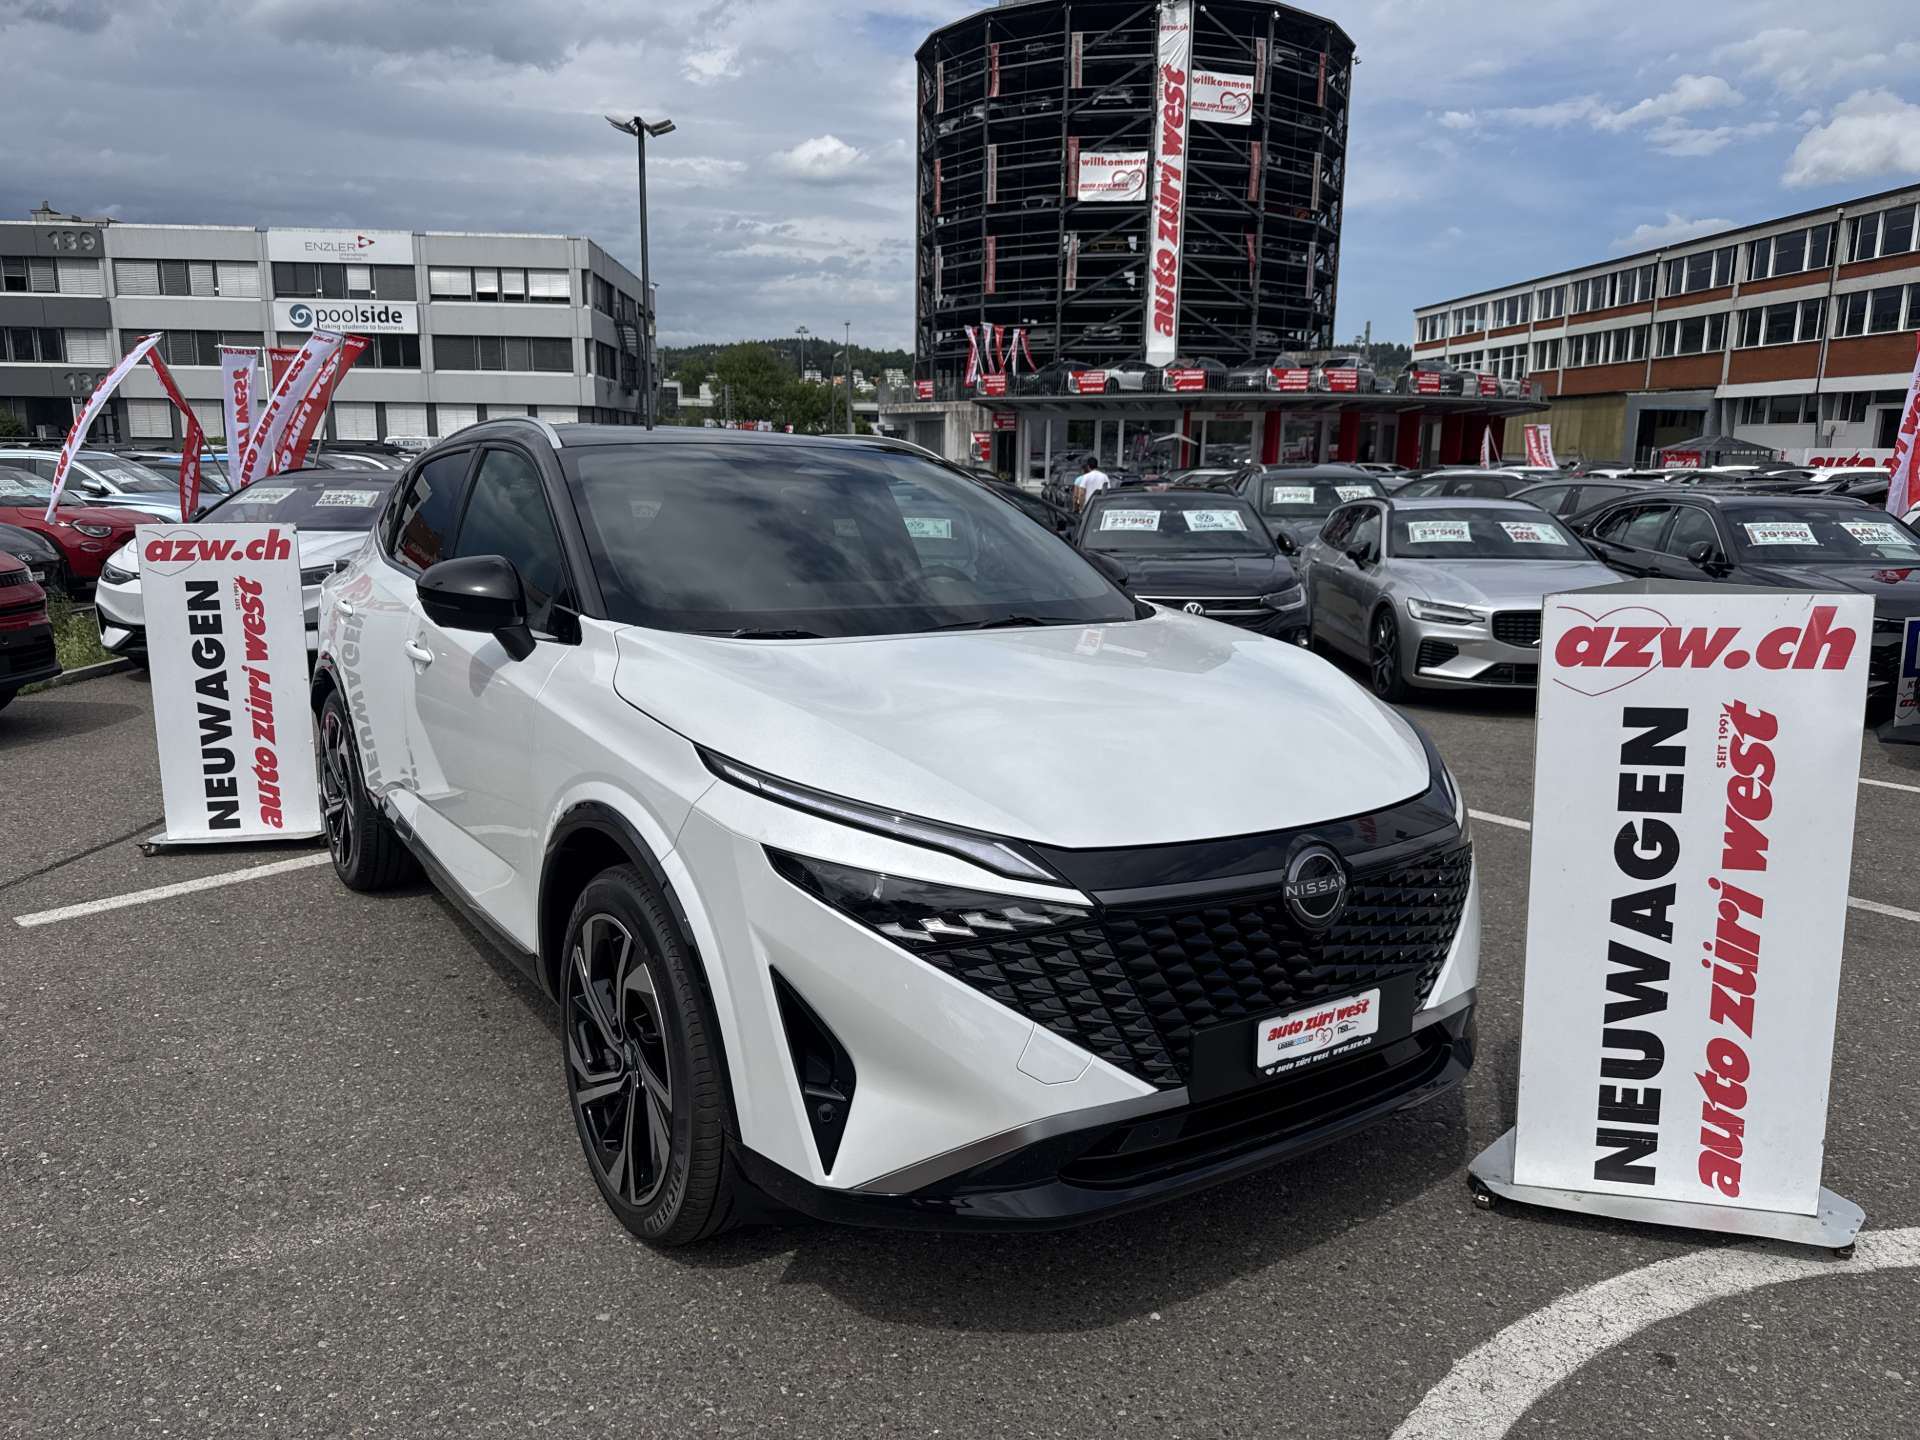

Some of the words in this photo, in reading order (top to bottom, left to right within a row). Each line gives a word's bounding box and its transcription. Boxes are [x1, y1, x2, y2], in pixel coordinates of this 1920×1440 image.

[1162, 63, 1185, 156] west
[1192, 75, 1252, 90] willkommen
[1081, 156, 1146, 167] willkommen
[1154, 159, 1183, 248] züri
[48, 231, 96, 250] 139
[305, 241, 356, 252] ENZLER
[316, 305, 403, 328] poolside
[1153, 247, 1177, 338] auto
[144, 529, 292, 562] azw.ch
[1759, 530, 1809, 538] 39'950
[233, 575, 270, 661] west
[1555, 606, 1857, 670] azw.ch
[185, 580, 241, 830] NEUWAGEN
[241, 665, 277, 746] züri
[1718, 713, 1730, 740] 1991
[1716, 744, 1727, 769] SEIT
[250, 746, 284, 830] auto
[1720, 699, 1779, 871] west
[1285, 874, 1346, 897] NISSAN
[1594, 706, 1689, 1186] NEUWAGEN
[1701, 876, 1766, 1039] züri
[1267, 1020, 1304, 1042] auto
[1304, 1007, 1337, 1032] züri
[1337, 998, 1370, 1021] west
[1276, 1062, 1295, 1073] auto
[1313, 1050, 1329, 1062] west
[1332, 1036, 1373, 1056] www.azw.ch
[1693, 1036, 1752, 1199] auto
